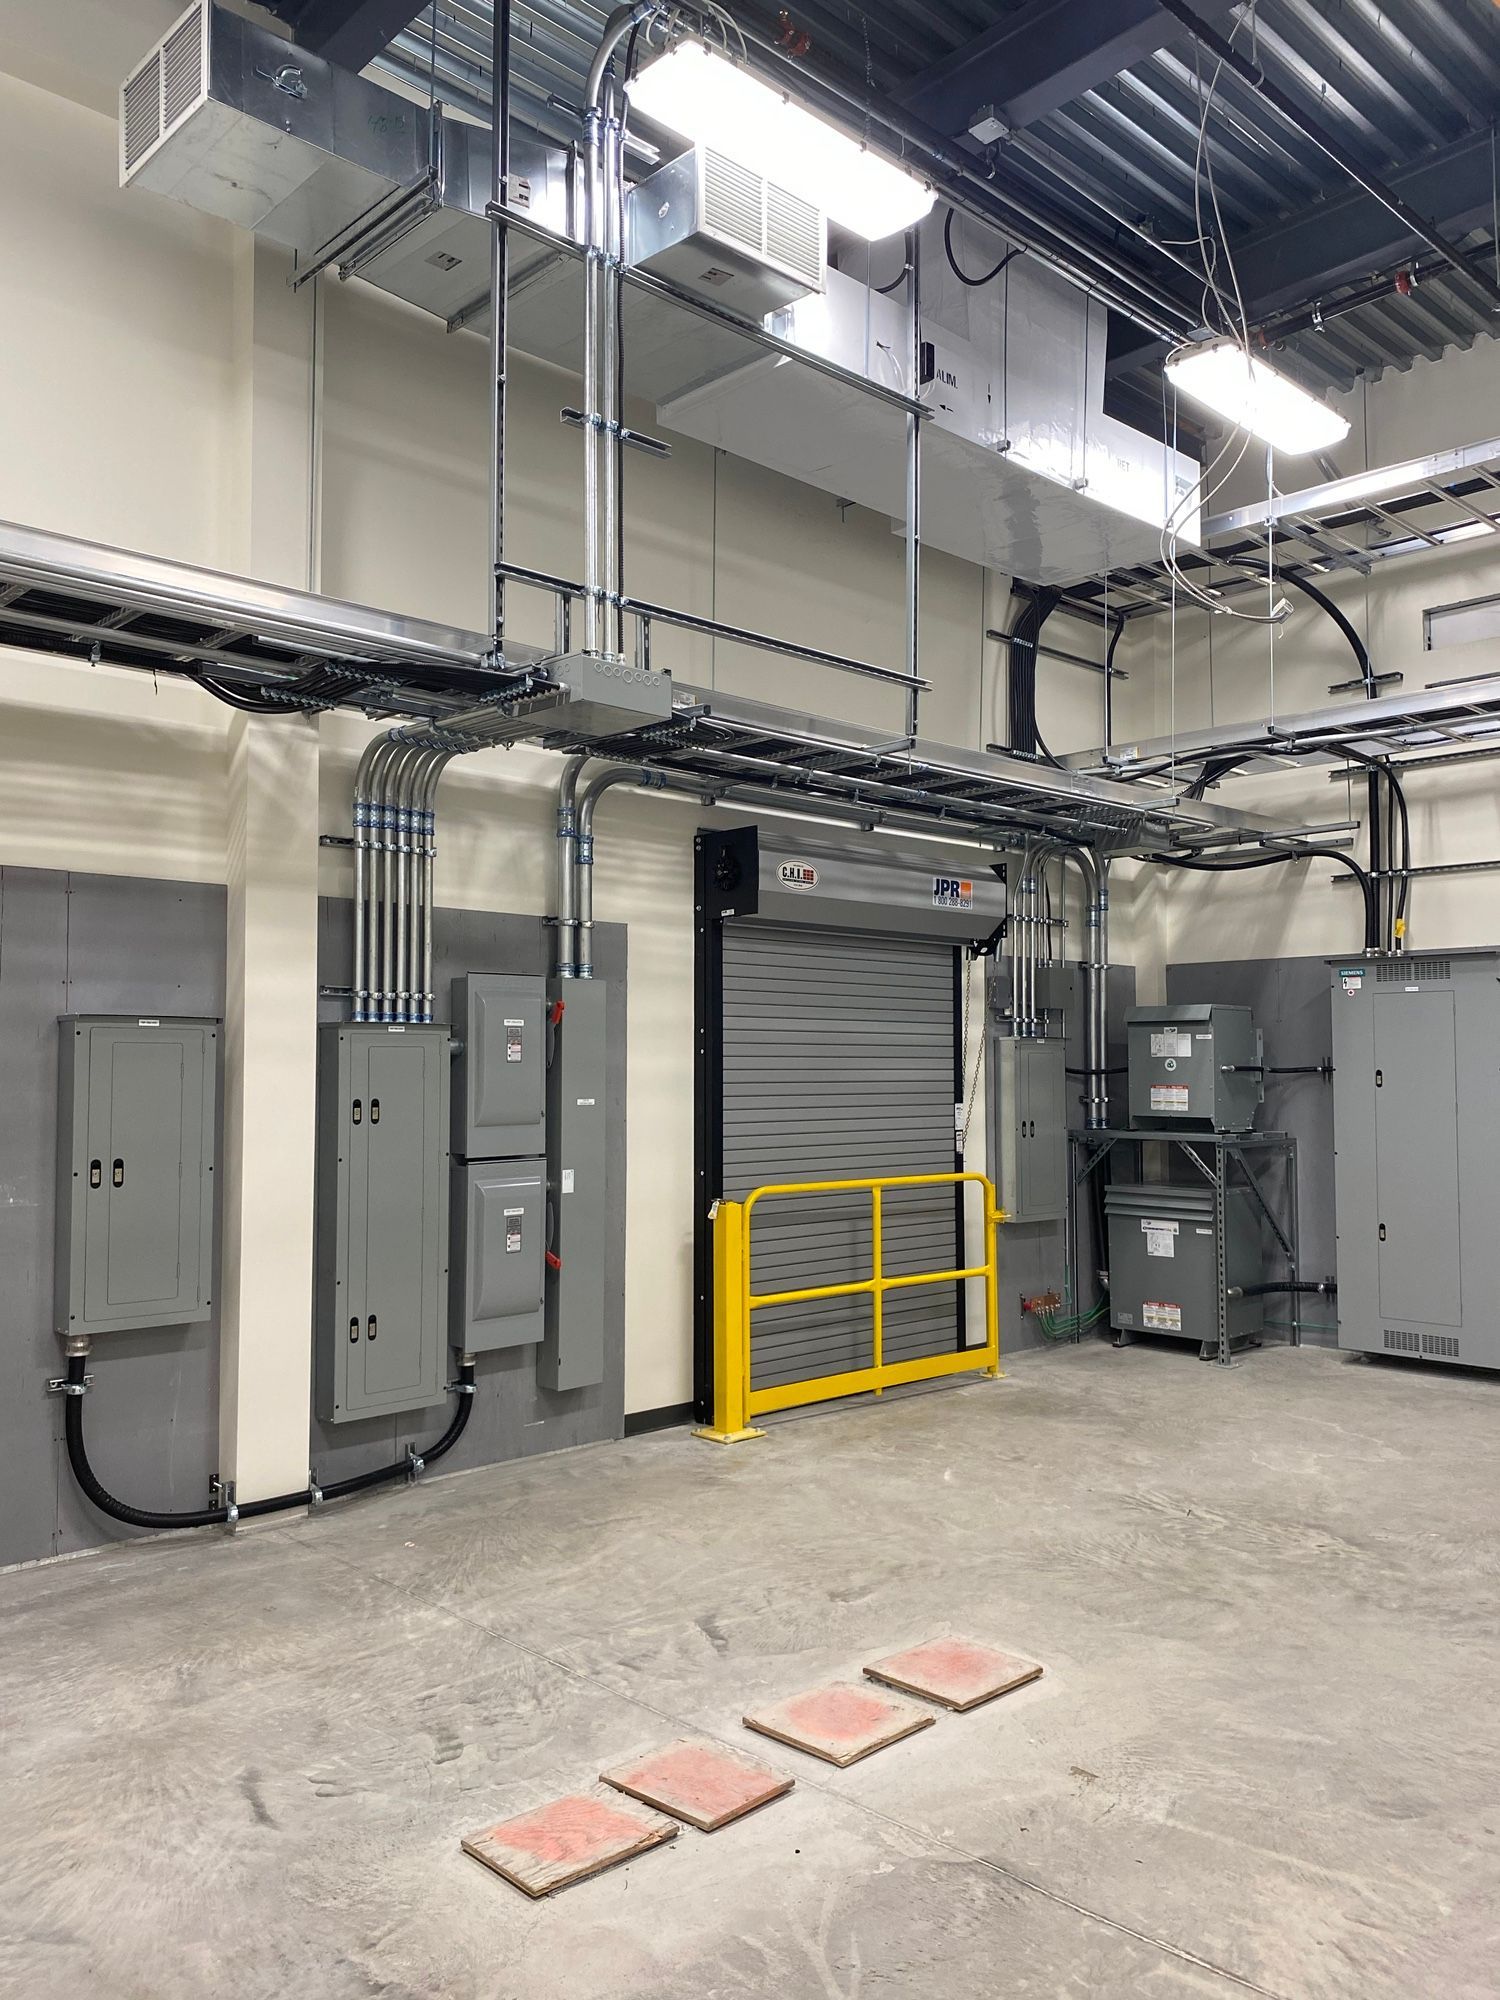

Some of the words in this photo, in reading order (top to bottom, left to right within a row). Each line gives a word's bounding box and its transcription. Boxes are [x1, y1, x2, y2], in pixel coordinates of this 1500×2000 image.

[782, 866, 803, 879] C.H.I.
[934, 878, 960, 898] JPR
[938, 895, 947, 906] 800
